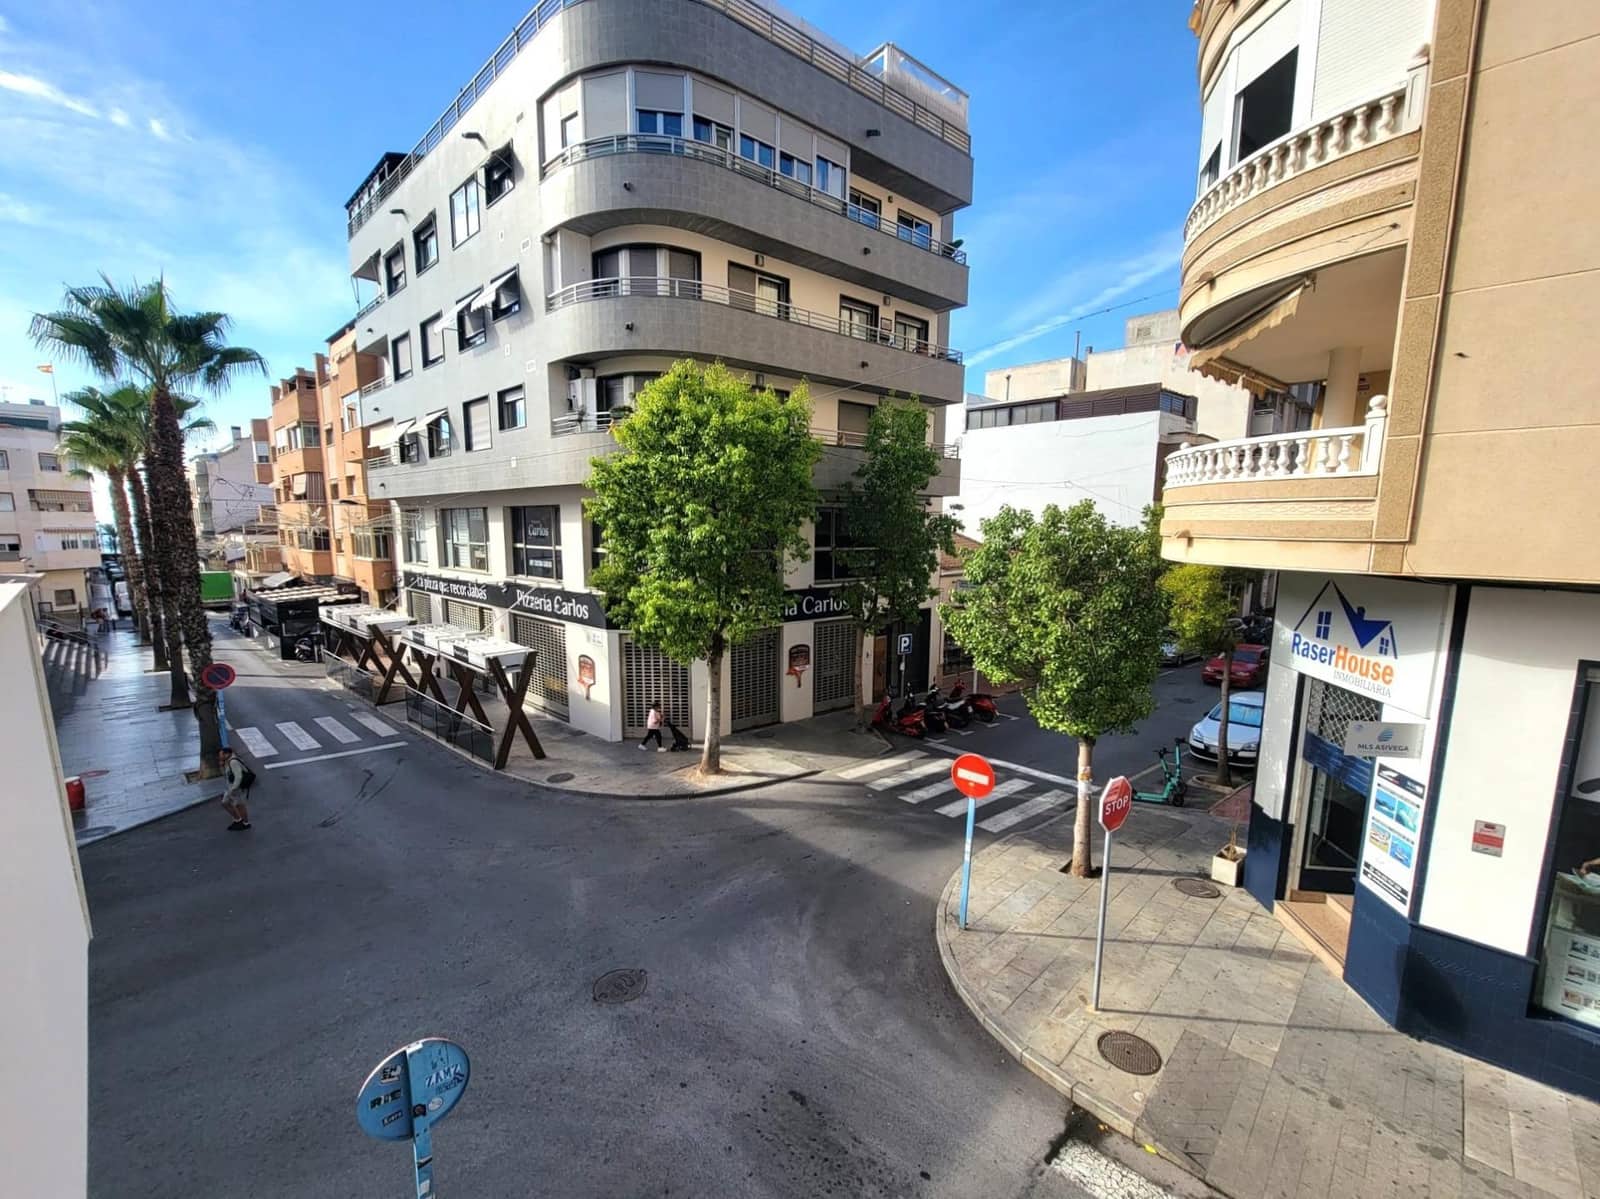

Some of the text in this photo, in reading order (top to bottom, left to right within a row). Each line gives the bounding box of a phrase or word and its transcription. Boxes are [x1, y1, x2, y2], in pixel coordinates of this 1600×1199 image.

[516, 589, 589, 620] Pizzeria Carlos
[802, 595, 850, 615] Carlos
[901, 637, 910, 652] P
[1292, 633, 1394, 685] RaserHouse
[1333, 670, 1392, 698] INMOBILIARIA
[1105, 795, 1129, 816] STOP
